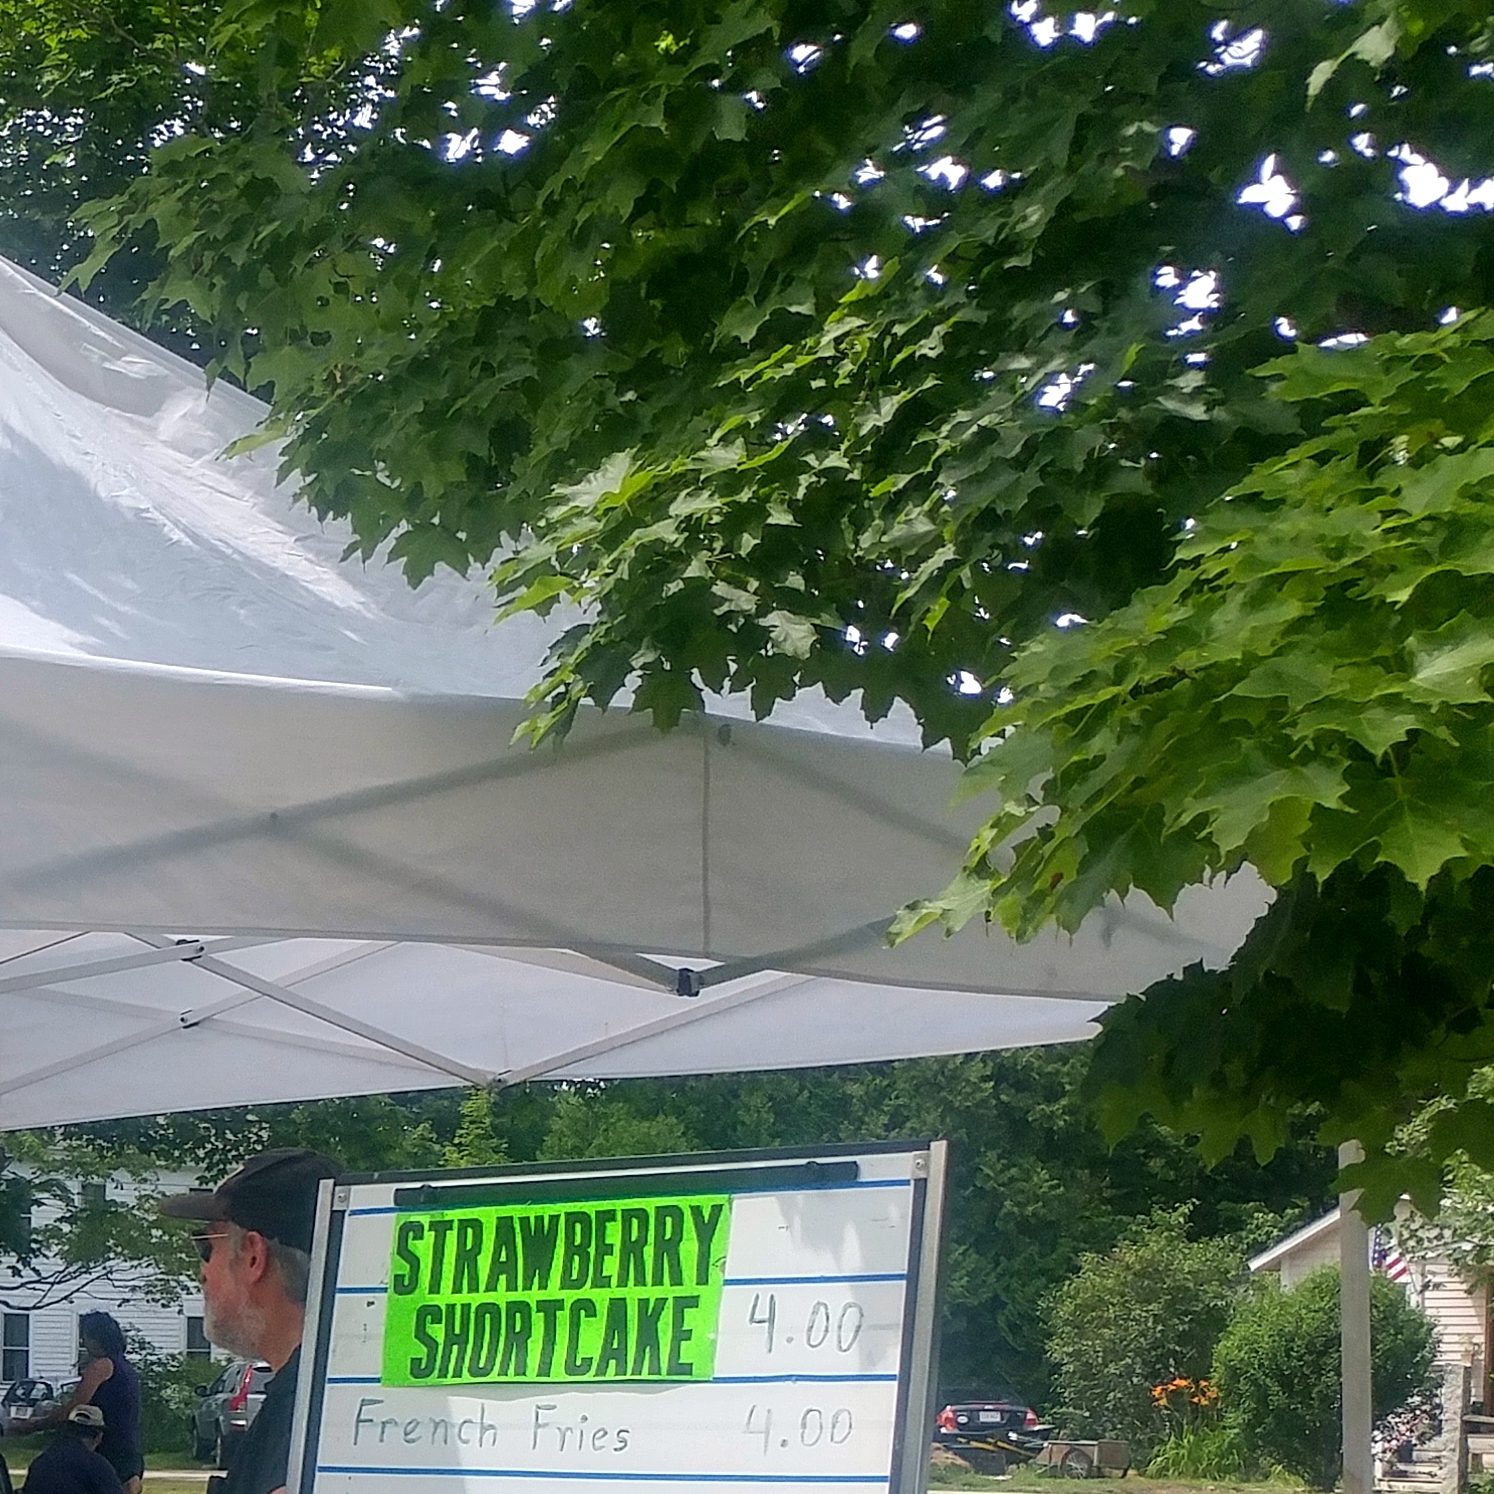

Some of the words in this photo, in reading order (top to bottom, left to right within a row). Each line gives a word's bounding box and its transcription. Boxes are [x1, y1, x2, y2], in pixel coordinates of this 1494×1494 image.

[393, 1202, 726, 1296] STRAWBERRY
[411, 1296, 700, 1380] SHORTCAKE
[748, 1292, 865, 1354] 4.00
[352, 1398, 498, 1450] French
[532, 1404, 630, 1454] Fries
[741, 1406, 854, 1450] 4.00
